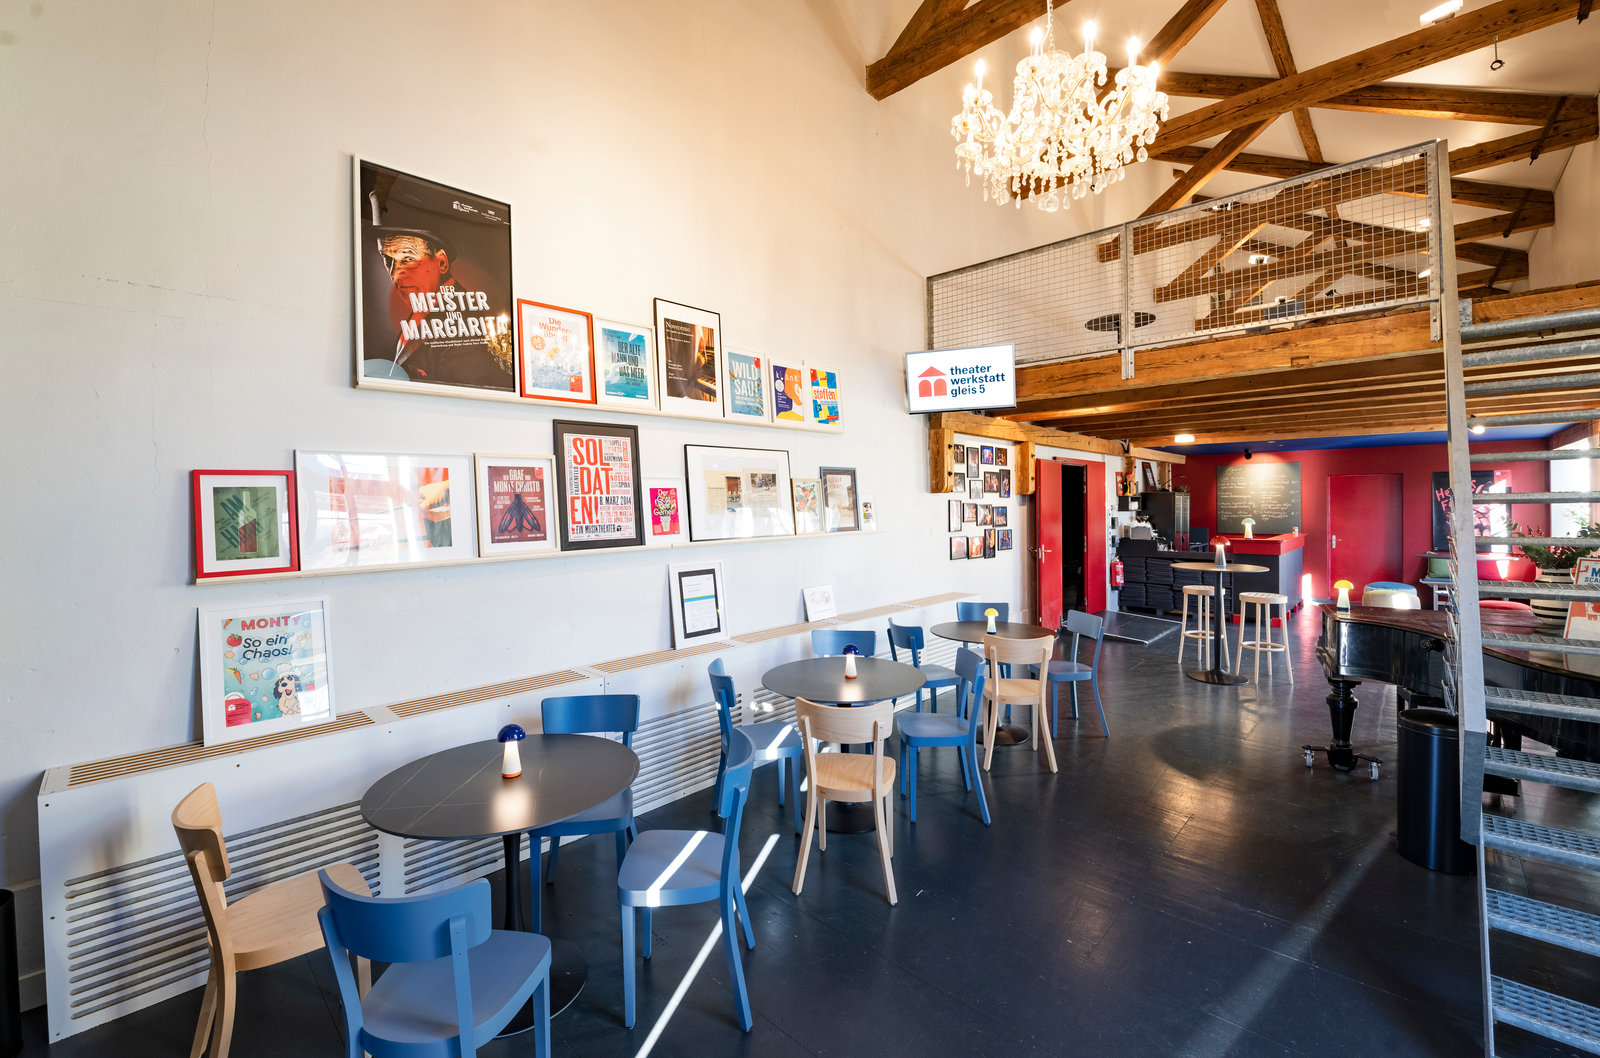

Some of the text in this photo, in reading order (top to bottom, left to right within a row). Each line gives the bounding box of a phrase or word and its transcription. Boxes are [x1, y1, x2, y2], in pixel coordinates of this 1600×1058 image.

[440, 286, 455, 295] DER
[409, 292, 490, 313] MEISTER
[446, 312, 462, 320] UND
[549, 317, 562, 326] Die
[400, 316, 508, 340] MARGARITA
[618, 342, 641, 356] DER ALTE
[611, 352, 639, 367] MANN UND
[630, 366, 645, 380] MEER
[732, 360, 758, 380] WILD
[950, 365, 992, 376] theater
[950, 373, 1006, 385] werkstatt
[951, 385, 985, 398] gleis 5
[572, 437, 611, 467] SOL
[493, 480, 541, 493] MONTE CHRISTO
[579, 466, 614, 495] DAT
[620, 496, 632, 505] 2014
[570, 496, 599, 525] EN!
[576, 525, 584, 534] EIN
[1591, 567, 1600, 577] M
[241, 616, 300, 631] MONTY
[243, 634, 288, 649] So ein
[242, 644, 293, 660] Chaos!
